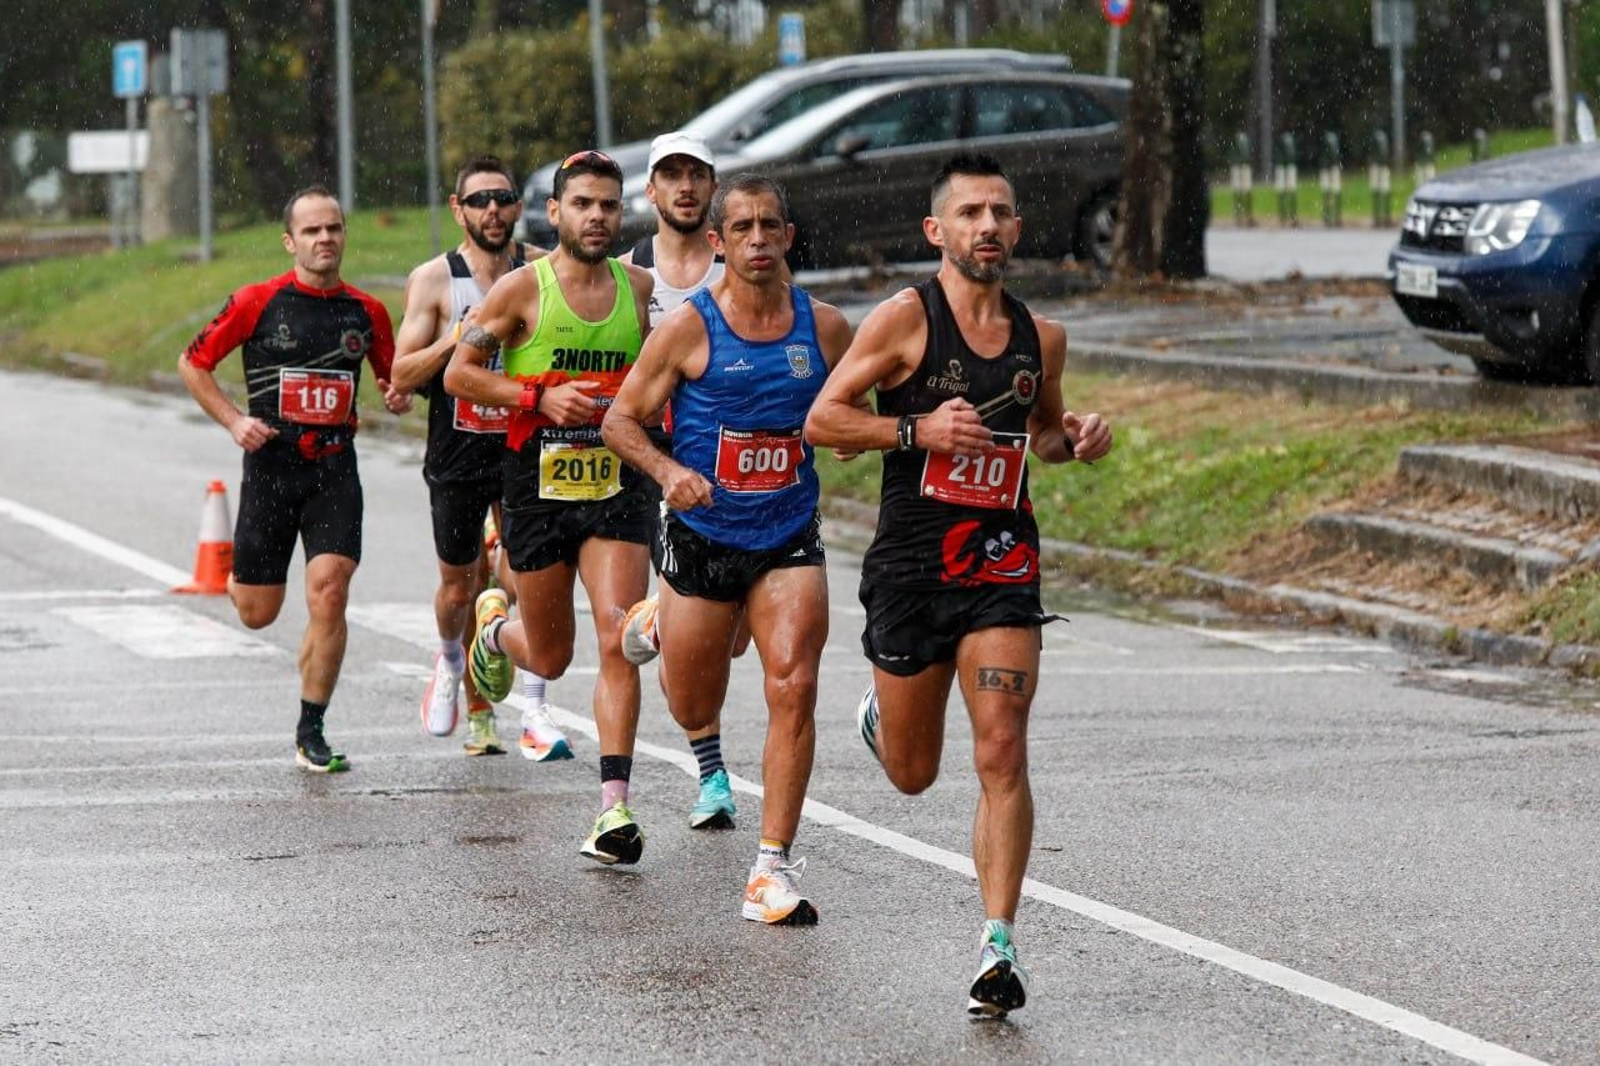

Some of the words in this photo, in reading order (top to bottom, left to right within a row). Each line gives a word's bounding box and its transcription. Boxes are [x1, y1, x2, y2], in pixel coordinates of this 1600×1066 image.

[551, 348, 626, 373] 3NORTH
[938, 377, 971, 394] Trigal
[297, 386, 338, 411] 116
[552, 456, 612, 481] 2016
[738, 447, 788, 473] 600
[948, 454, 1006, 487] 210
